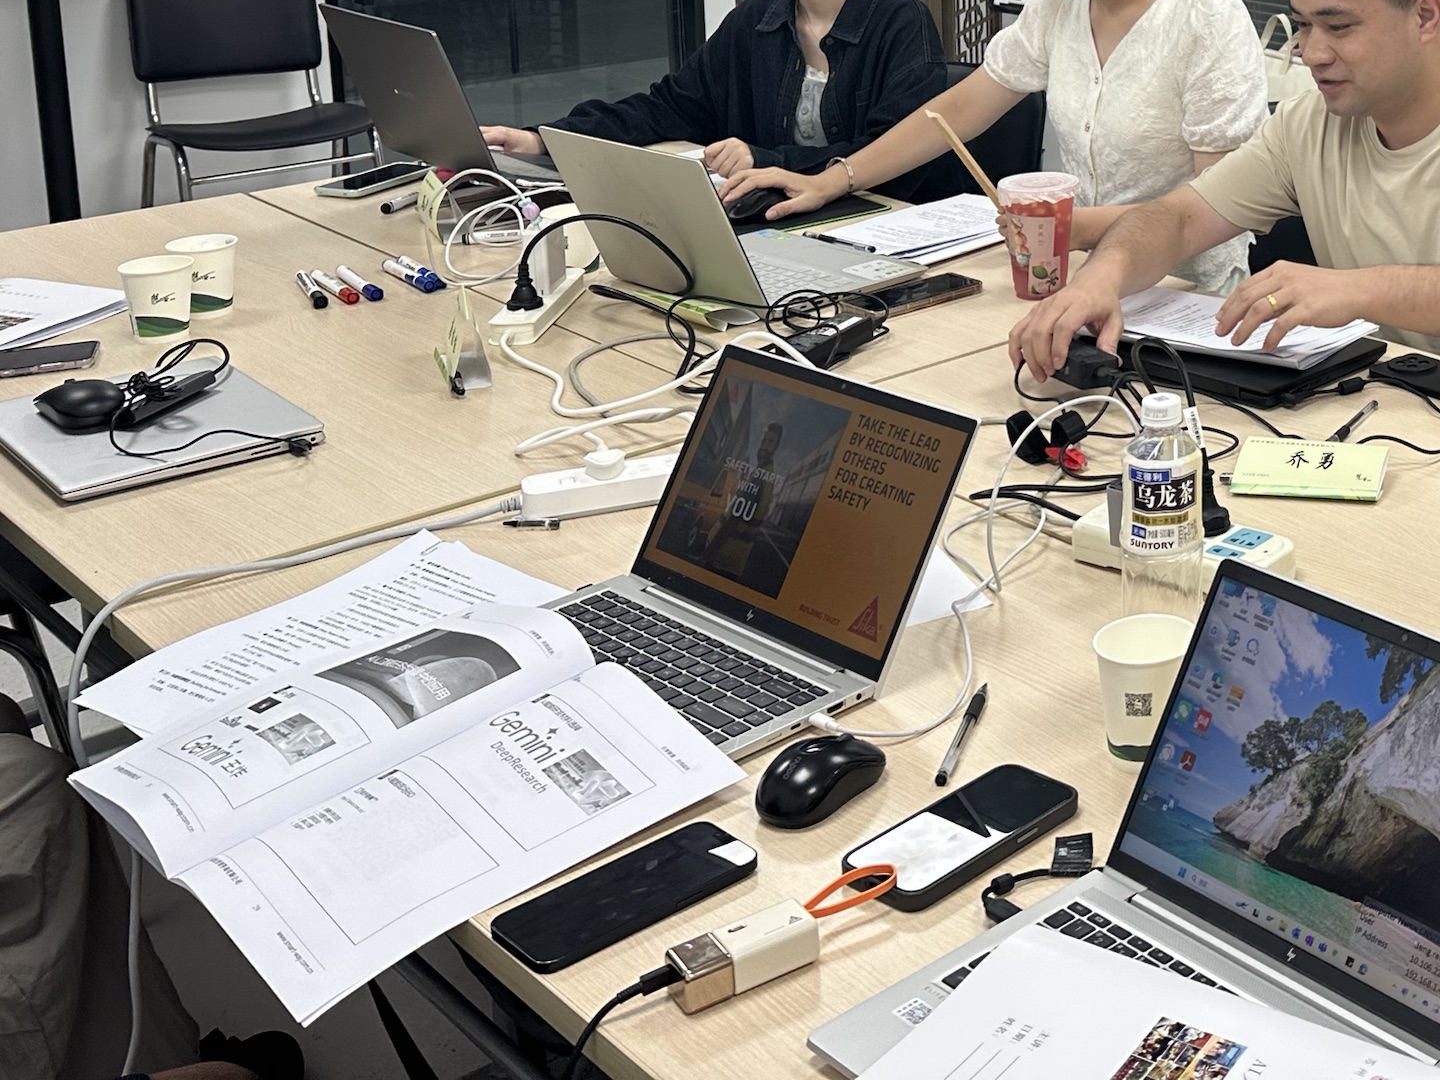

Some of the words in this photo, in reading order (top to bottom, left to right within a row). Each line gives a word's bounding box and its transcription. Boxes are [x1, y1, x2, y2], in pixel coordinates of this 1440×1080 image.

[857, 414, 885, 435] TAKE
[888, 424, 908, 442] THE
[910, 432, 940, 452] LEAD
[842, 450, 887, 476] OTHERS
[849, 432, 864, 447] BY
[866, 437, 941, 474] RECOGNIZING
[724, 456, 752, 478] SAFETY
[752, 466, 786, 487] STARTS
[1136, 472, 1162, 482] 三得利
[736, 480, 760, 496] WITH
[828, 486, 872, 511] SAFETY
[835, 468, 857, 486] FOR
[859, 476, 916, 506] CREATING
[1136, 480, 1193, 508] 乌龙茶
[725, 492, 758, 522] YOU
[1130, 538, 1174, 550] SUNTORY
[489, 709, 564, 763] Gemini
[180, 736, 242, 766] Gemini
[491, 740, 548, 795] DeepResearch
[1360, 912, 1376, 926] User
[1362, 930, 1389, 950] Address
